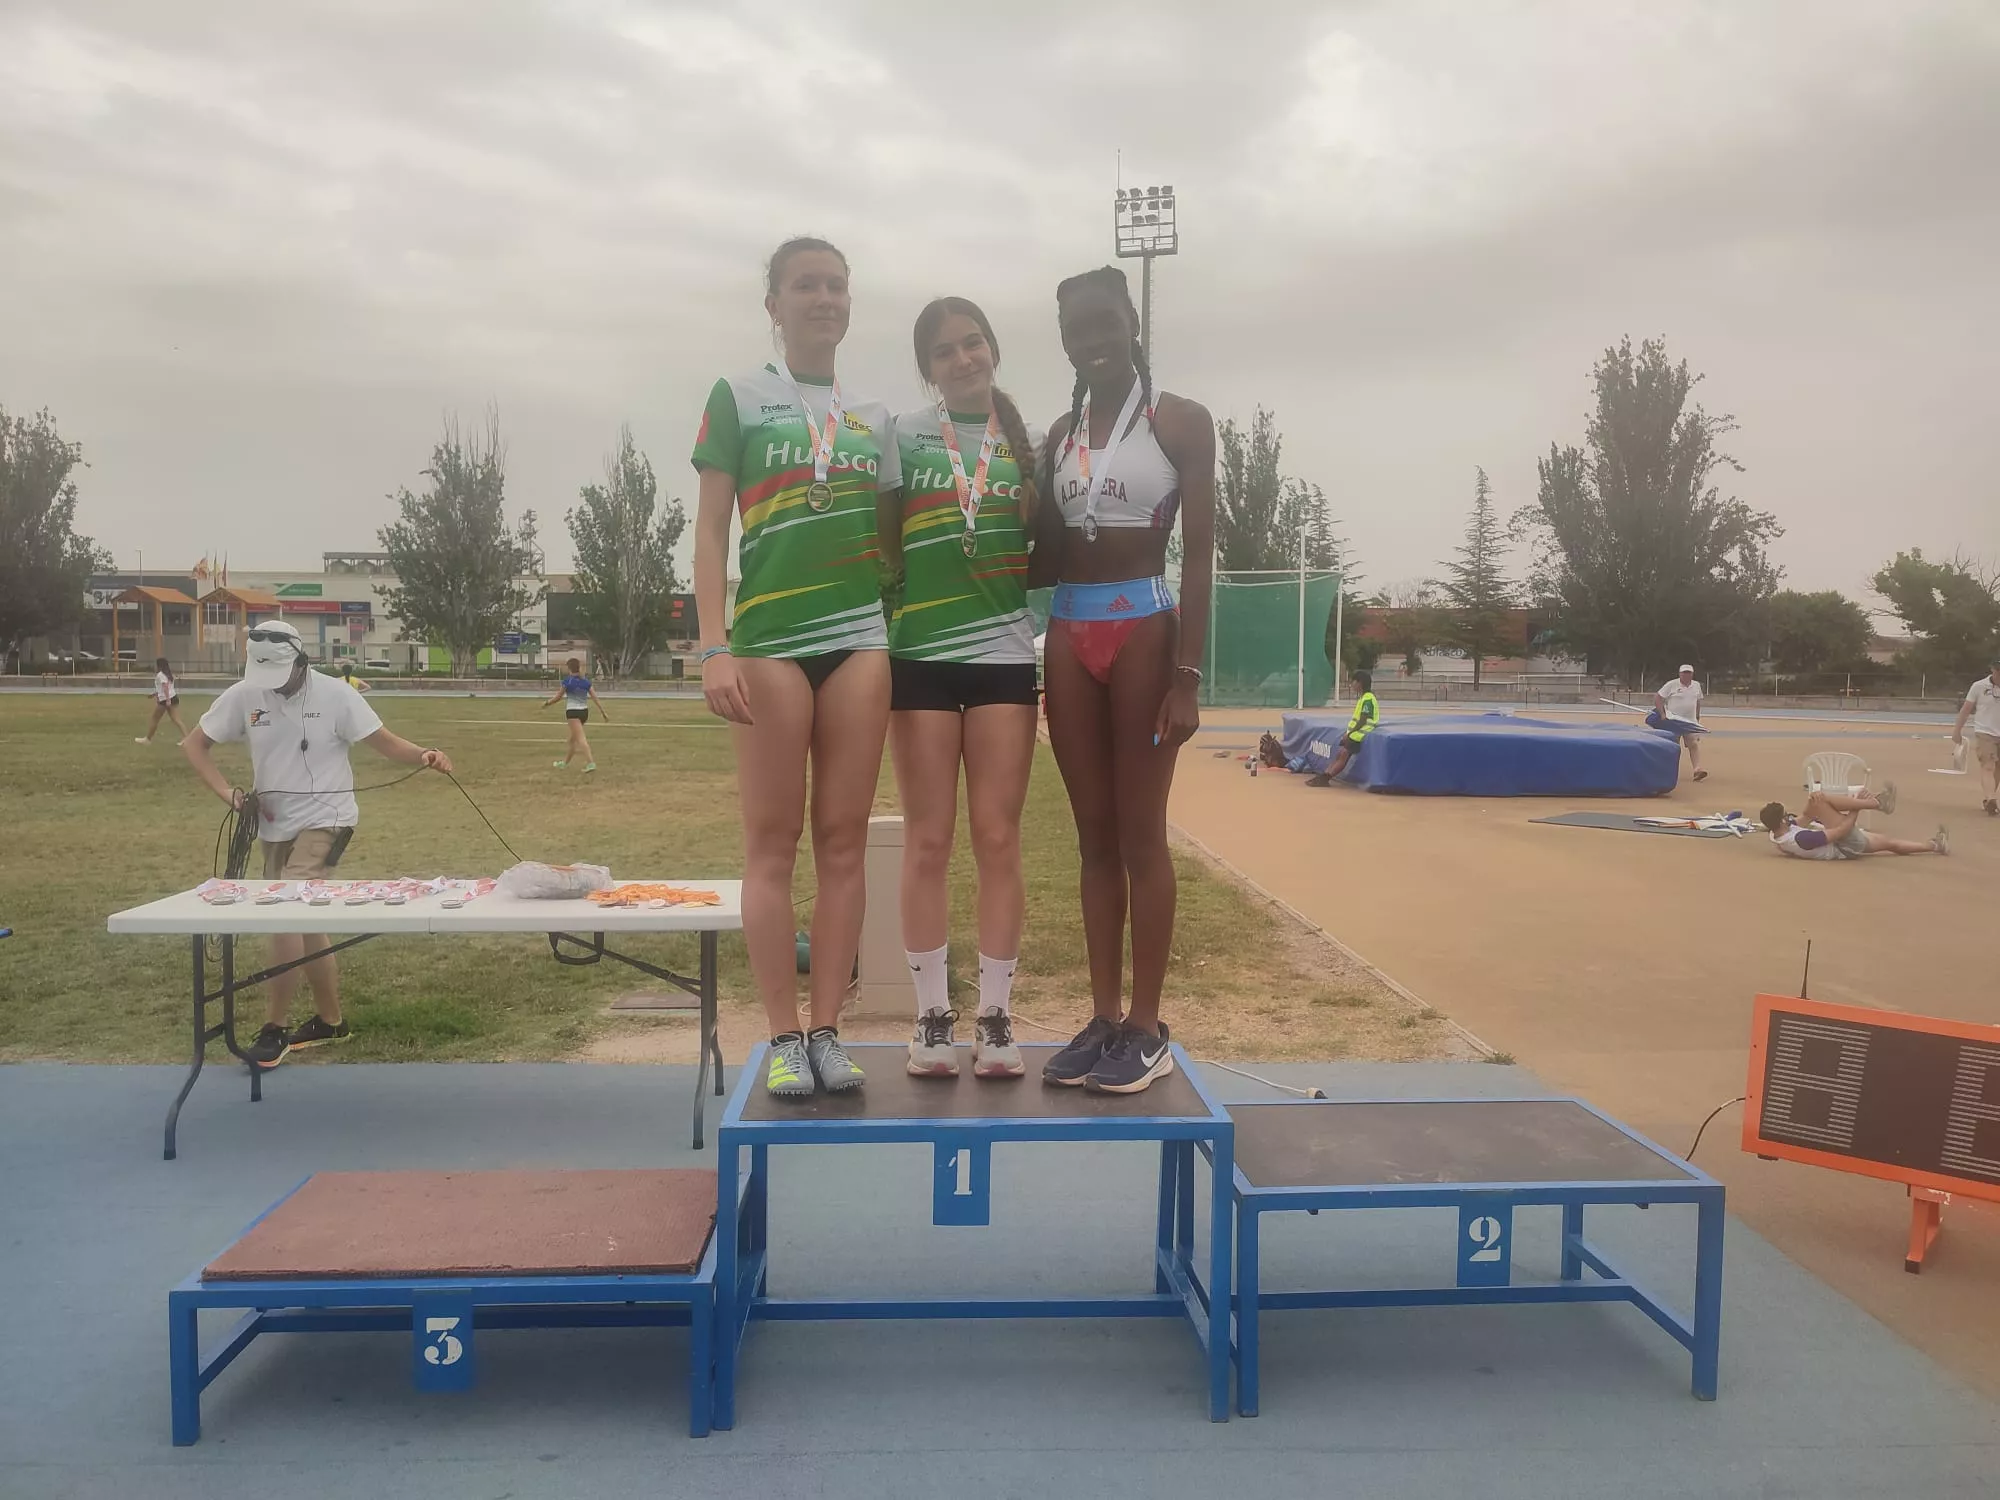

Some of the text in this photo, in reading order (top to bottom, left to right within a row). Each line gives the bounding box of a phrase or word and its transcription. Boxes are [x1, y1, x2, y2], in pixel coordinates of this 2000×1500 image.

[948, 1149, 973, 1195] 1
[1469, 1216, 1501, 1262] 2
[424, 1317, 463, 1365] 3
